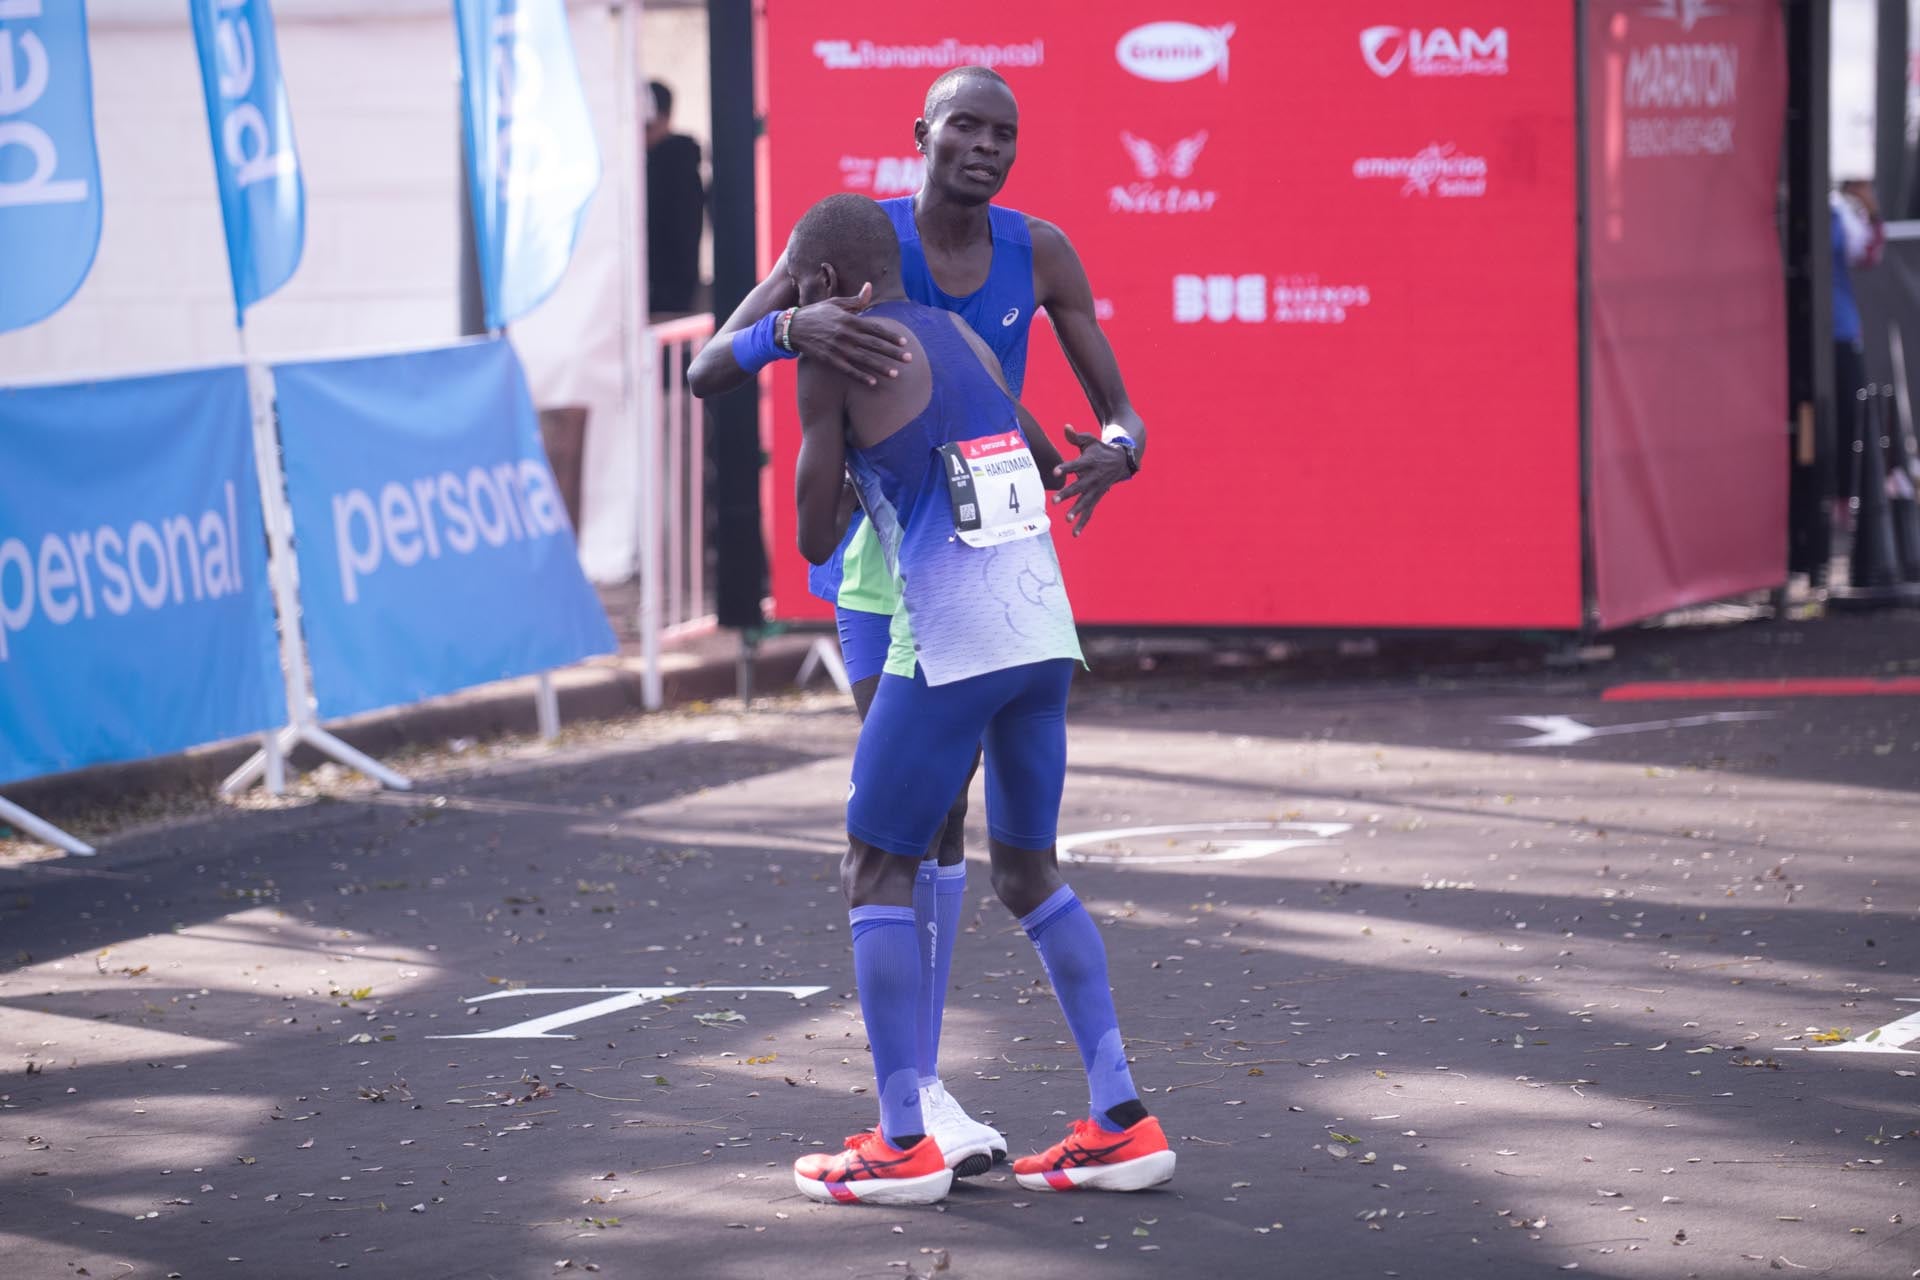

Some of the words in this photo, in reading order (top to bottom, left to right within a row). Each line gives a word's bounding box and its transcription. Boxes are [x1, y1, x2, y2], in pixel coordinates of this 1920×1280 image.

[1409, 27, 1508, 61] IAM
[951, 454, 965, 474] A
[985, 456, 1033, 476] HAKIZIMANA
[1009, 482, 1020, 513] 4
[0, 480, 244, 661] personal
